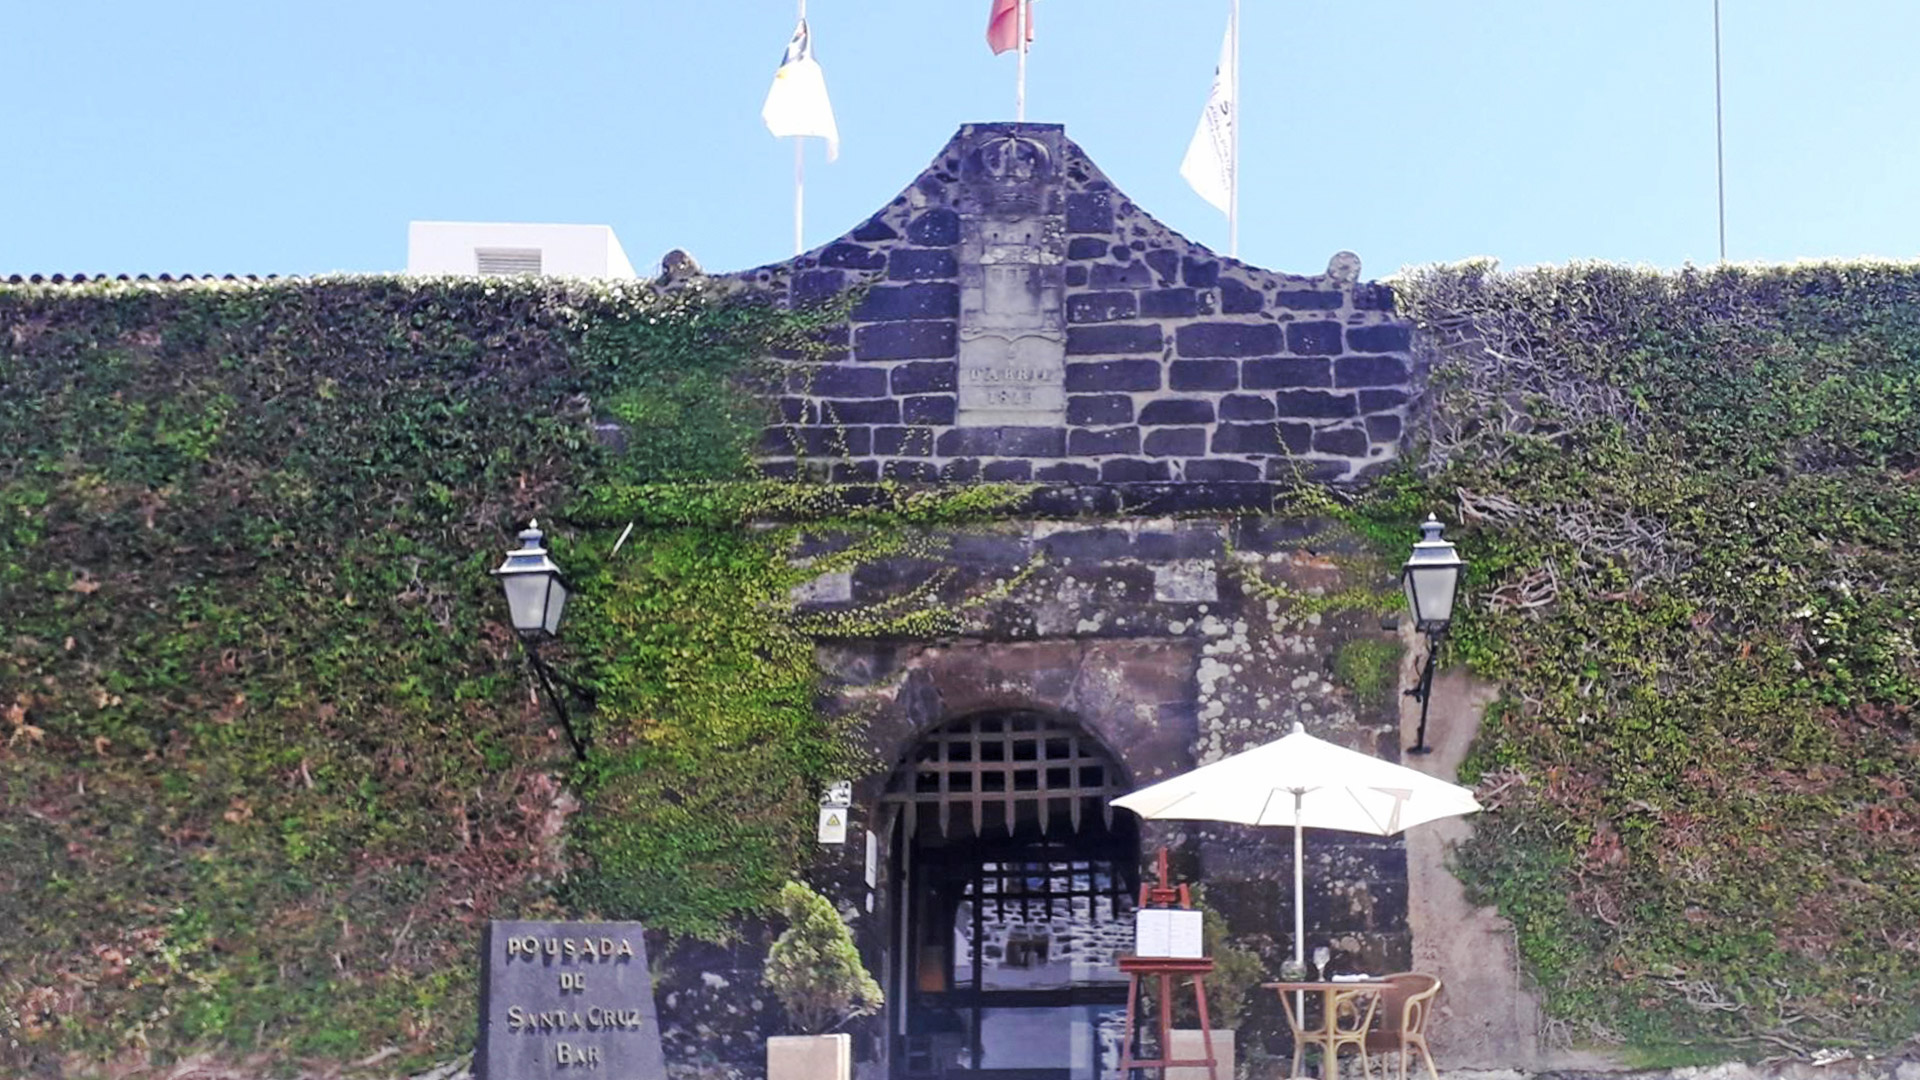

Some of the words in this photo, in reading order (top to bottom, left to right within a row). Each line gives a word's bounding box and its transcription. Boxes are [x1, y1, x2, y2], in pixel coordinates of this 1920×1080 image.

[507, 936, 634, 957] POUSADA
[560, 972, 586, 990] DE
[507, 1005, 581, 1028] SANTA
[588, 1005, 643, 1027] CRUZ
